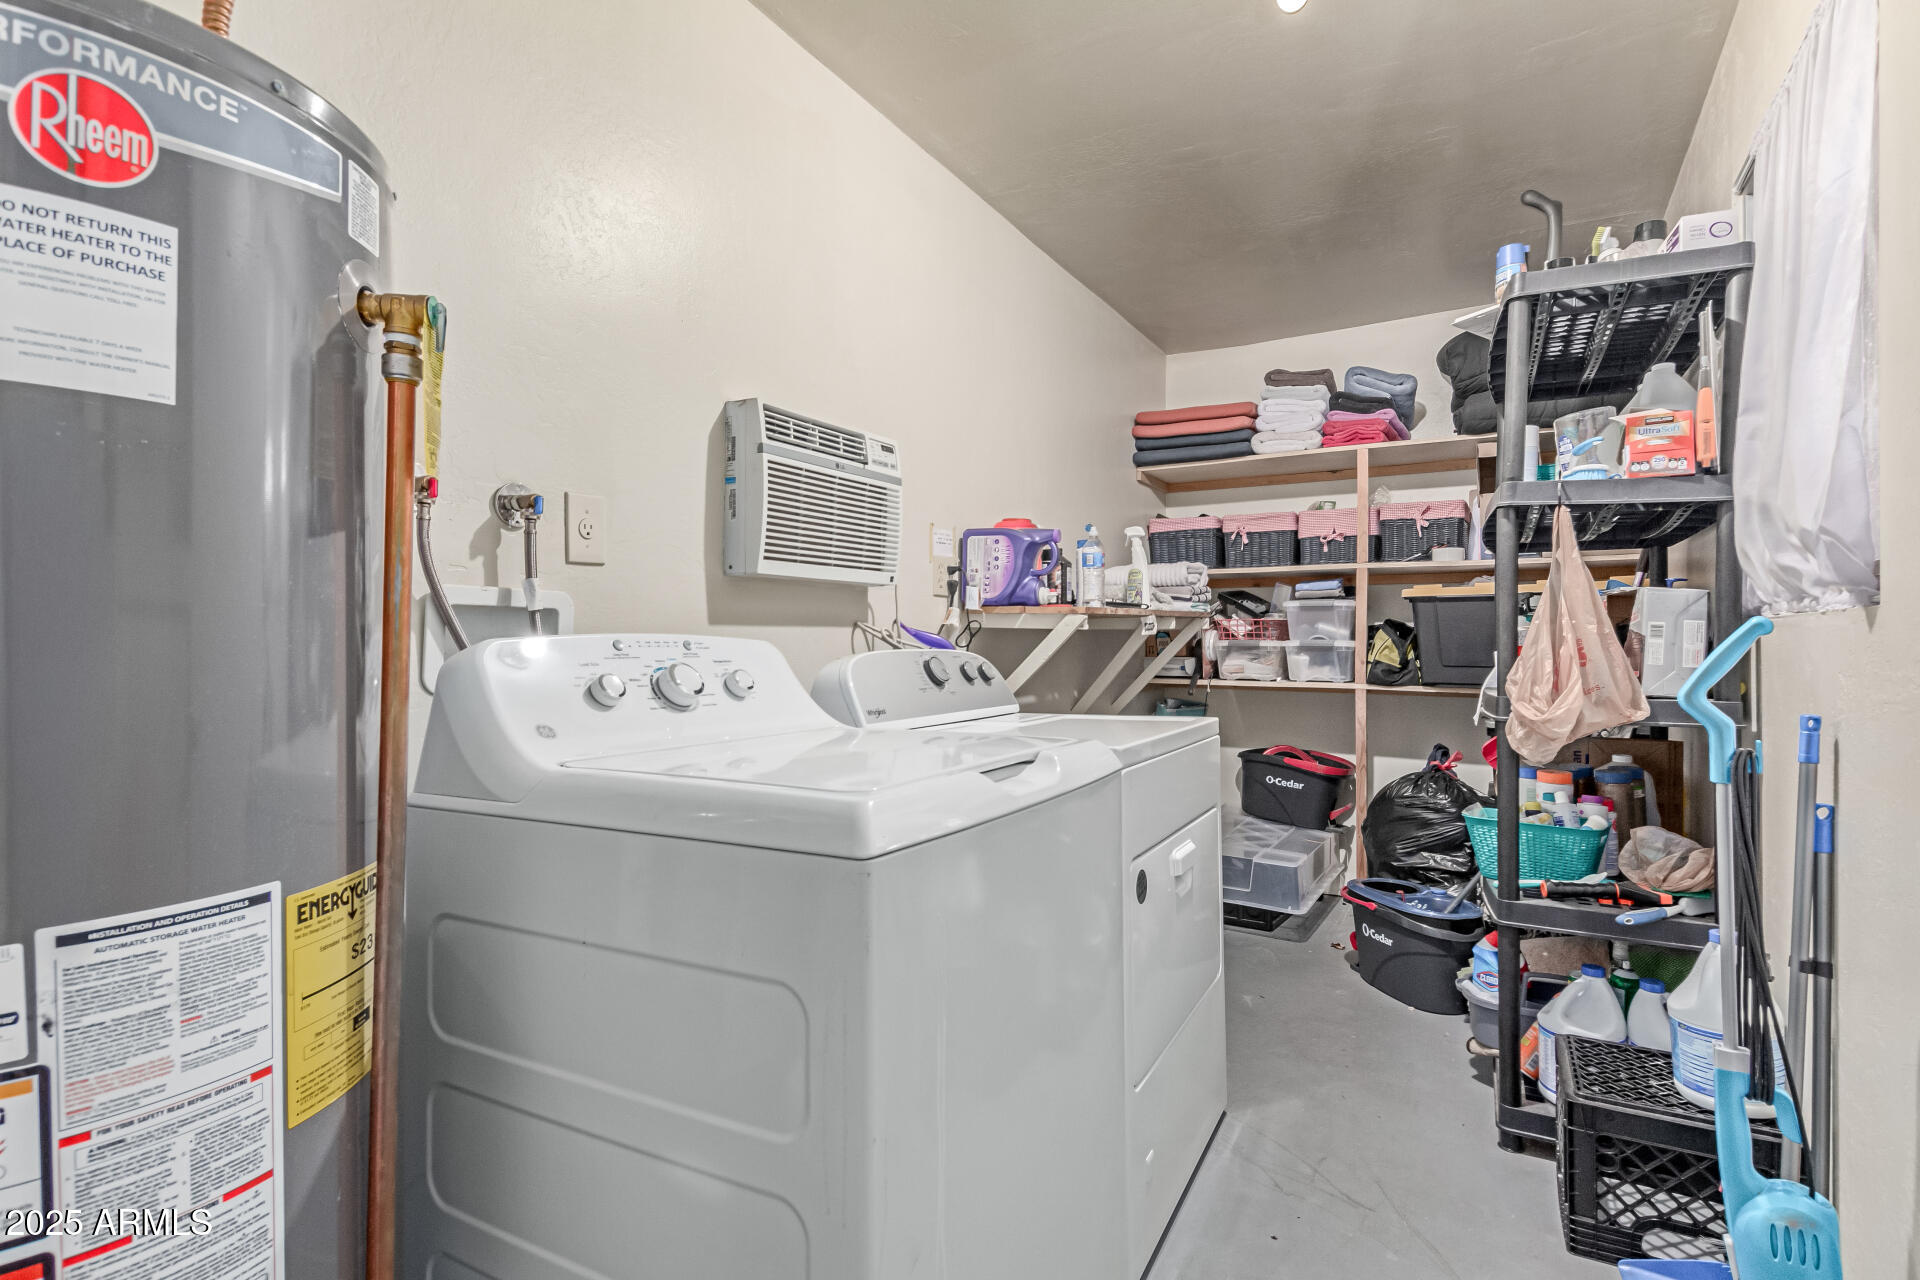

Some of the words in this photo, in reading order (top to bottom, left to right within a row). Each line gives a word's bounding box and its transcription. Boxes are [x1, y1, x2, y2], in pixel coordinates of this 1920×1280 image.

[30, 73, 149, 168] Rheem
[0, 200, 16, 212] O
[22, 203, 60, 221] NOT
[65, 213, 133, 239] RETURN
[138, 231, 172, 250] THIS
[0, 217, 47, 236] ATER
[51, 227, 116, 252] HEATER
[119, 243, 141, 258] TO
[144, 249, 173, 267] THE
[52, 246, 75, 260] OF
[80, 252, 167, 282] PURCHASE
[1265, 775, 1305, 790] O-Cedar
[154, 916, 174, 928] AND
[174, 907, 220, 923] OPERATION
[221, 899, 249, 913] DETAILS
[297, 872, 377, 925] ENERGYGUID
[94, 938, 149, 954] AUTOMATIC
[150, 929, 190, 943] STORAGE
[190, 922, 217, 934] WATER
[218, 914, 246, 927] HEATER
[1362, 923, 1394, 947] O-Cedar
[114, 1119, 135, 1132] YOUR
[137, 1109, 164, 1124] SAFETY
[166, 1103, 185, 1114] READ
[187, 1092, 212, 1107] BEFORE
[214, 1078, 248, 1096] OPERATING
